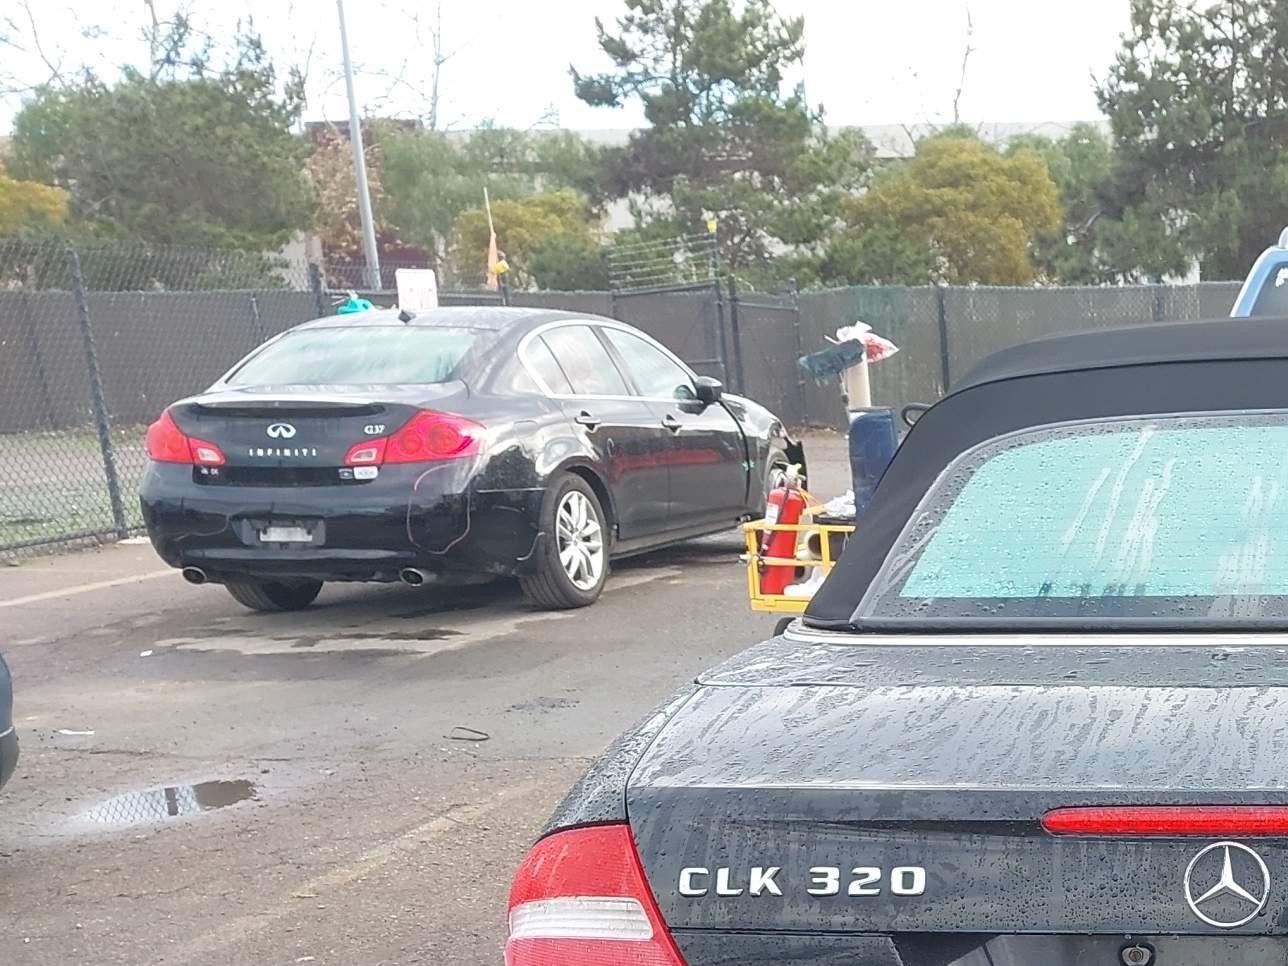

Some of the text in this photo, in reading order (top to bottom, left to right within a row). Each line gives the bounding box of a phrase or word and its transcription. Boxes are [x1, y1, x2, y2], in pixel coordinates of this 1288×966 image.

[364, 424, 385, 435] G37
[248, 448, 317, 457] INFINITI
[678, 866, 926, 897] CLK 320
